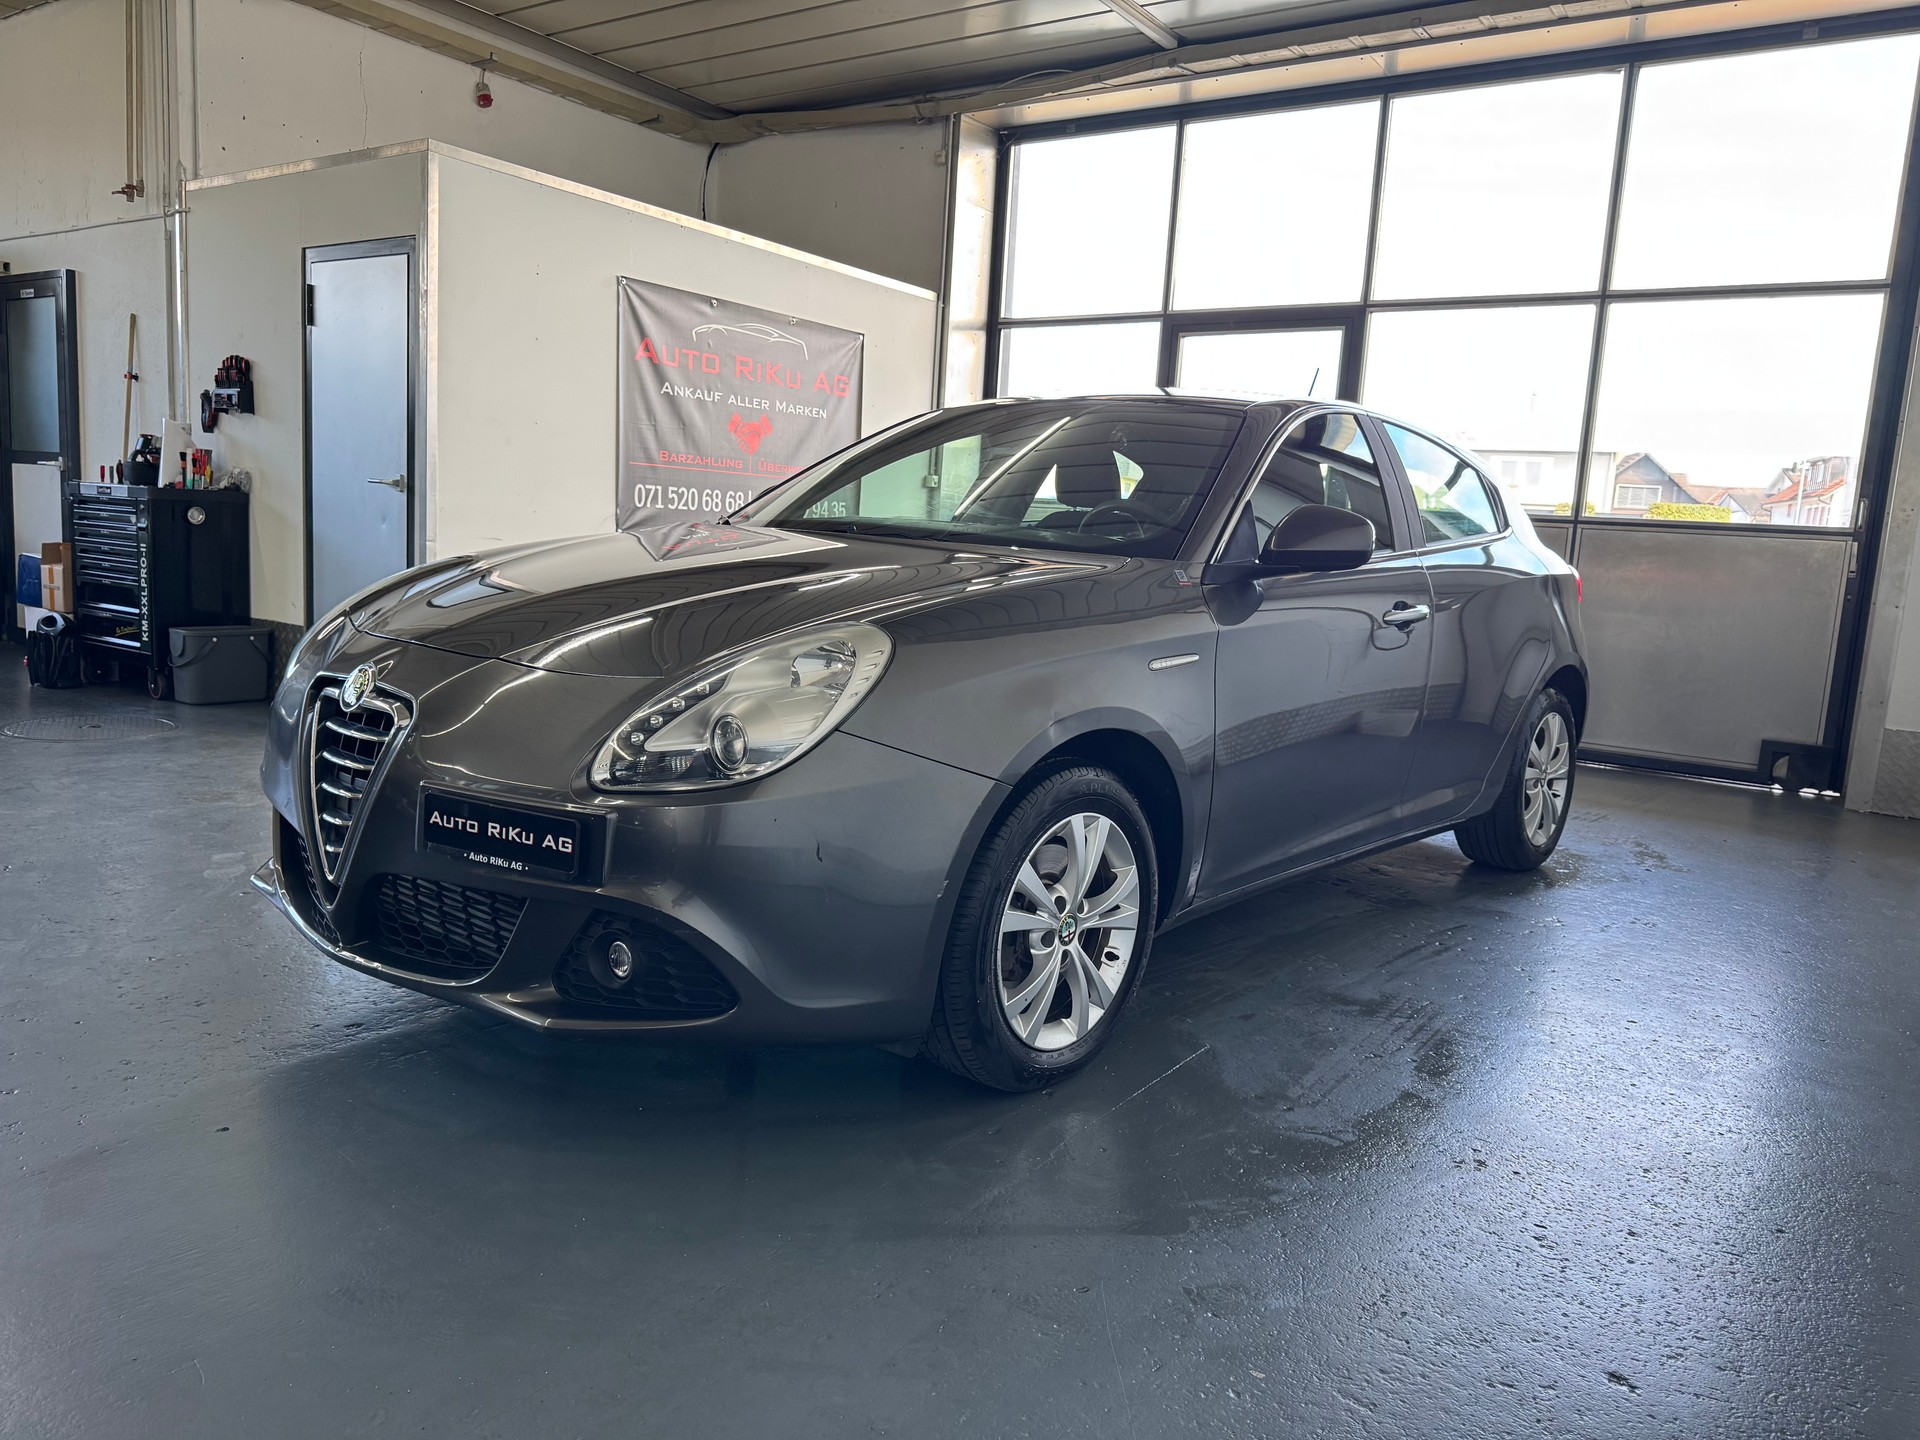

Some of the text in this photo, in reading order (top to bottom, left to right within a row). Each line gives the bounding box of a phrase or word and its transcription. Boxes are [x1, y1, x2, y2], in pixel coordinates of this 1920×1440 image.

[634, 336, 720, 375] AUTO
[812, 371, 849, 398] AG
[660, 381, 827, 419] ANKAUF ALLER MARKEN
[659, 450, 743, 469] BARZAHLUNG
[634, 483, 664, 509] 071
[668, 486, 699, 511] 520
[702, 489, 722, 512] 68
[725, 490, 744, 513] 68
[812, 501, 829, 517] 94
[831, 502, 846, 517] 35
[140, 543, 149, 642] KM-XXLPRO-II
[429, 810, 479, 833] AUTO
[541, 834, 573, 853] AG
[468, 852, 523, 871] Auto RiKu AG
